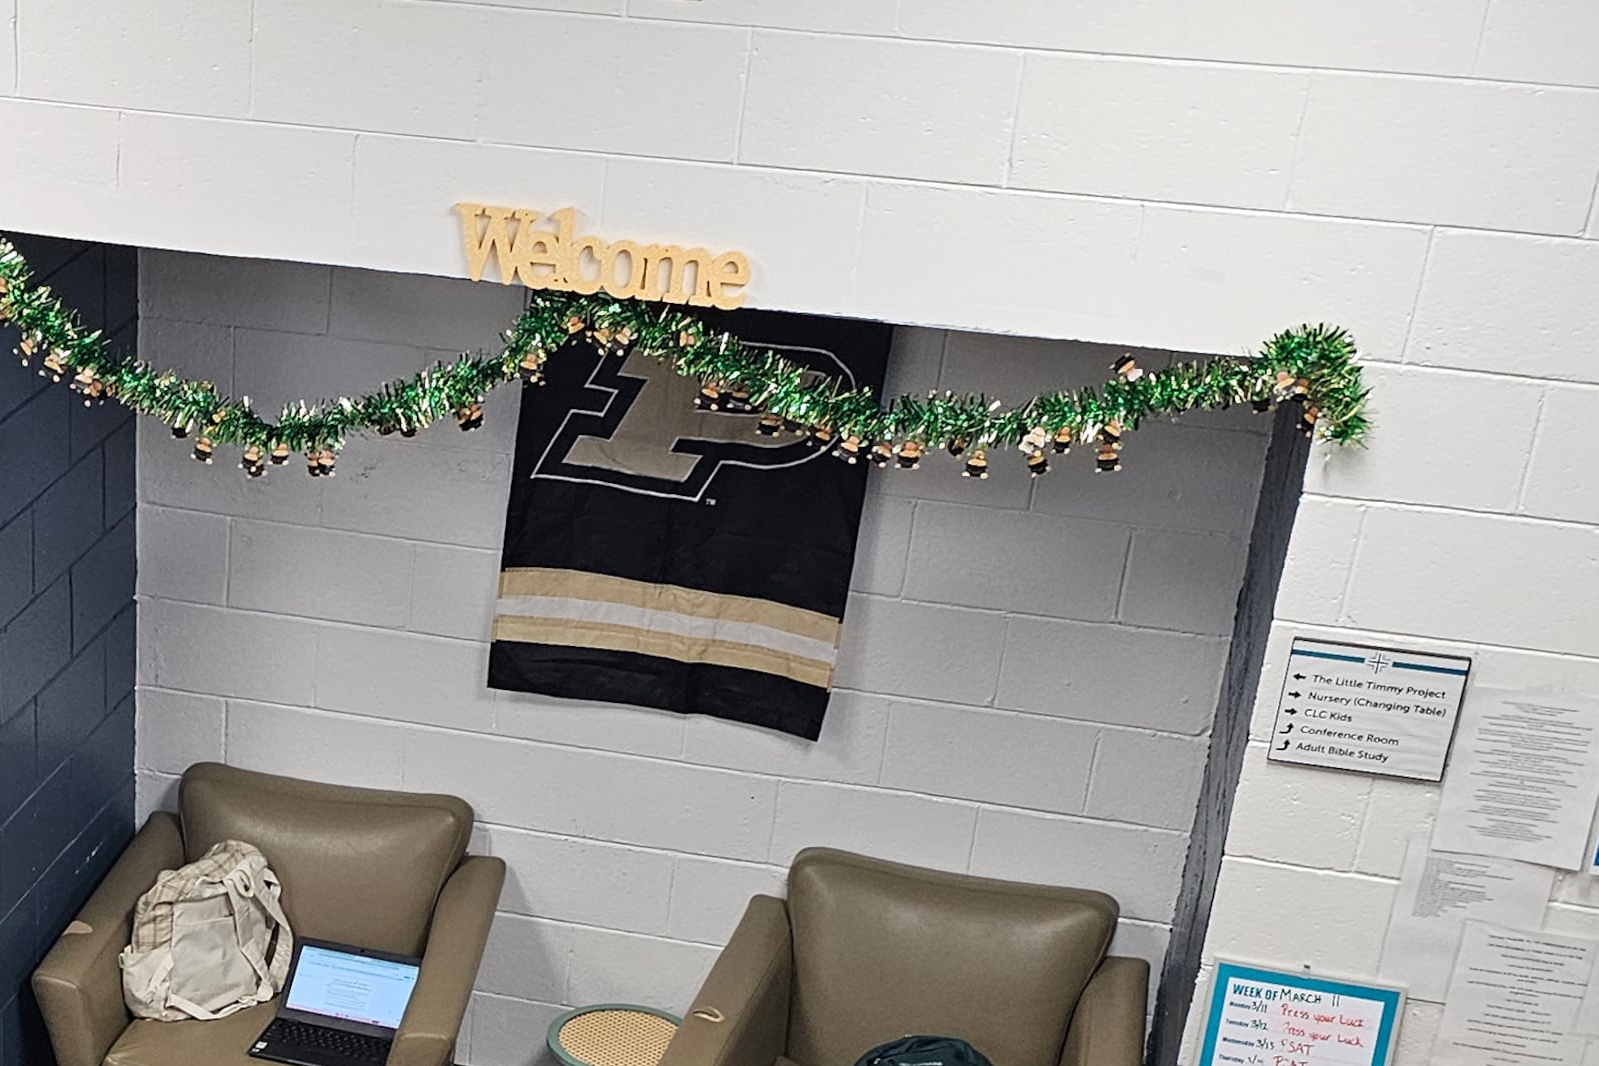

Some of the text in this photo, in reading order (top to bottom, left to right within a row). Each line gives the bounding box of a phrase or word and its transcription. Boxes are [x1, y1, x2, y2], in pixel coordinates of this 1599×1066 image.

[455, 202, 752, 310] Welcome
[1313, 675, 1446, 700] The Little Timmy Project
[1308, 692, 1447, 718] Nursery (Changing Table)
[1304, 709, 1353, 723] CLC Kids
[1300, 725, 1400, 746] Conference Room
[1296, 742, 1390, 764] Adult Bible Study
[1232, 984, 1280, 1001] WEEK OF
[1279, 988, 1322, 1005] MARCH
[1251, 1001, 1268, 1015] 3/11
[1281, 1003, 1310, 1020] Press
[1313, 1013, 1337, 1026] your
[1308, 1030, 1332, 1042] your
[1337, 1033, 1364, 1048] Luck
